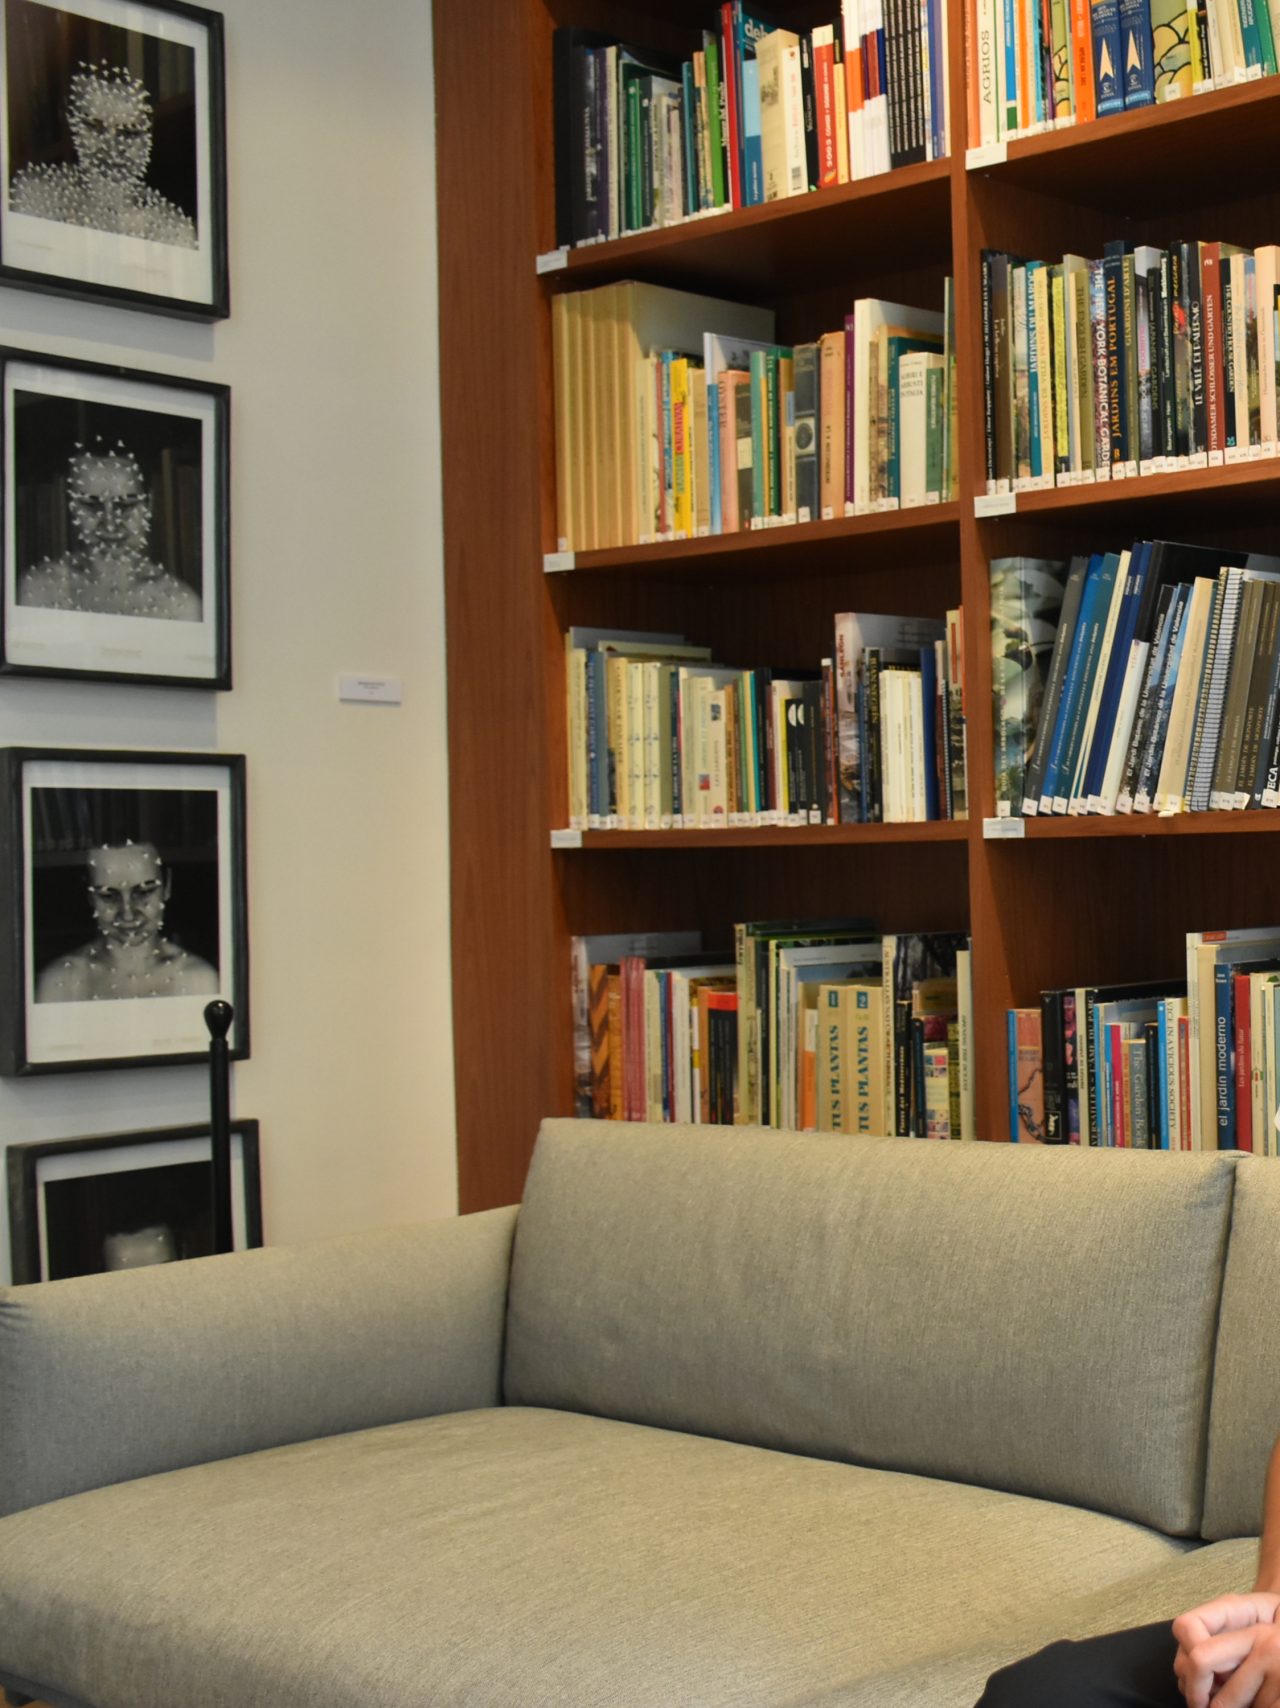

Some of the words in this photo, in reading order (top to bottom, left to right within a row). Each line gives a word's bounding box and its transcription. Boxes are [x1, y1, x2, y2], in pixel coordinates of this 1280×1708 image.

[981, 30, 991, 104] AGRIOS
[1094, 267, 1103, 289] THE
[1095, 293, 1104, 320] NEW
[1107, 285, 1117, 361] PORTUGAL
[1122, 306, 1131, 357] GIARDINI
[1192, 300, 1201, 350] PALERMO
[1096, 323, 1106, 357] YORK
[1207, 331, 1215, 352] UND
[1109, 365, 1118, 386] EM
[1194, 368, 1202, 391] VILLE
[1097, 358, 1108, 424] BOTANICAL
[1195, 394, 1203, 406] LE
[1110, 390, 1122, 448] JARDINS
[1151, 645, 1159, 656] de
[1170, 634, 1178, 645] de
[1140, 699, 1146, 708] la
[1157, 698, 1164, 709] de
[1159, 690, 1166, 698] la
[1138, 709, 1145, 718] de
[1127, 768, 1133, 777] El
[1144, 769, 1151, 778] El
[1217, 1016, 1227, 1071] moderno
[829, 1025, 840, 1095] PLANTAS
[856, 1026, 868, 1097] PLANTAS
[1134, 1048, 1143, 1070] The
[1134, 1073, 1145, 1115] Garden
[1217, 1075, 1230, 1111] jardín
[831, 1099, 841, 1130] TUS
[857, 1102, 869, 1133] TUS
[1169, 1088, 1177, 1130] SOCIETY
[1218, 1115, 1228, 1127] el
[1135, 1117, 1146, 1148] Book
